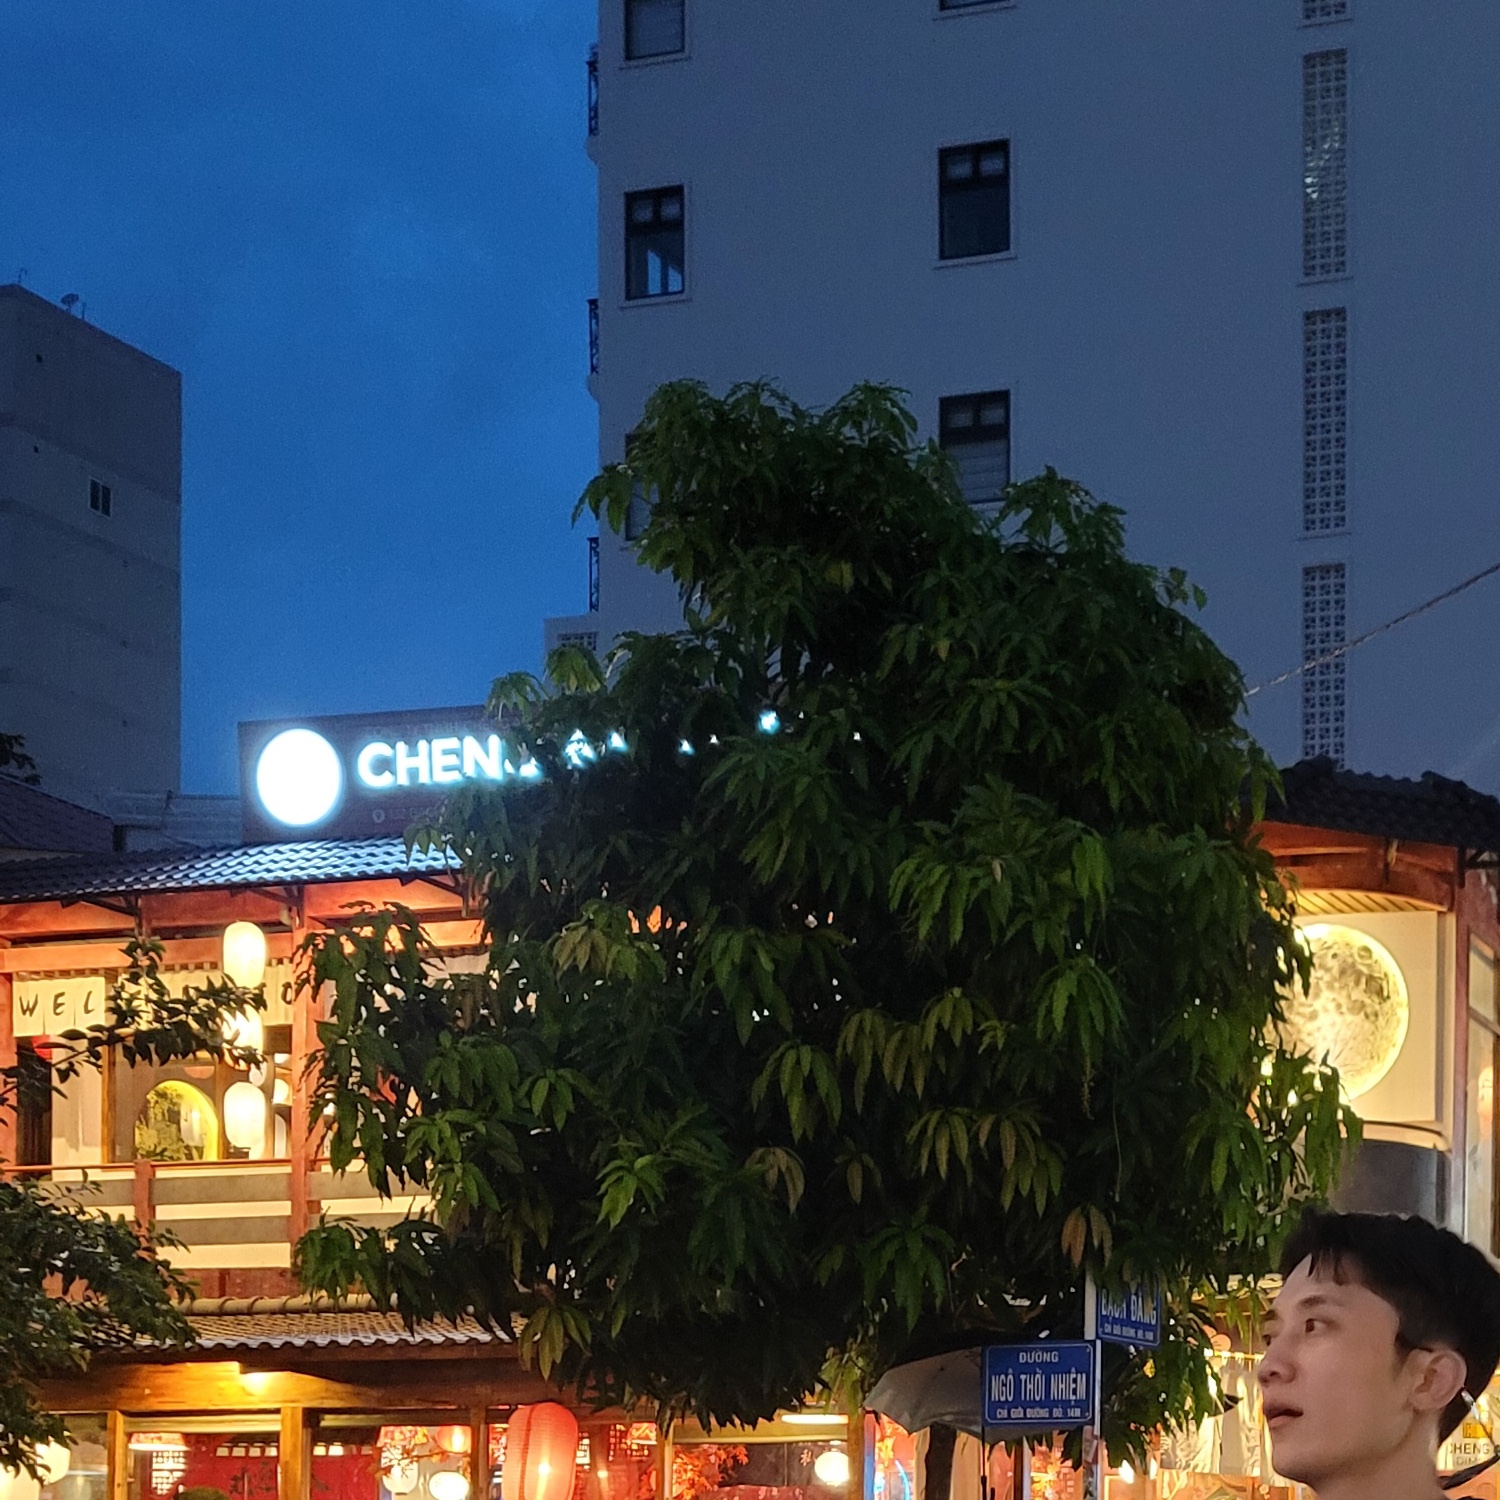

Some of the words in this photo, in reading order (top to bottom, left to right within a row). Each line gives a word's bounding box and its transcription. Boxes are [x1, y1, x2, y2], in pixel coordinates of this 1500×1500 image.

[356, 733, 541, 788] CHEN
[991, 1367, 1014, 1402] NGÔ
[1020, 1367, 1046, 1401] THỜI
[1050, 1367, 1087, 1406] NHIỆM
